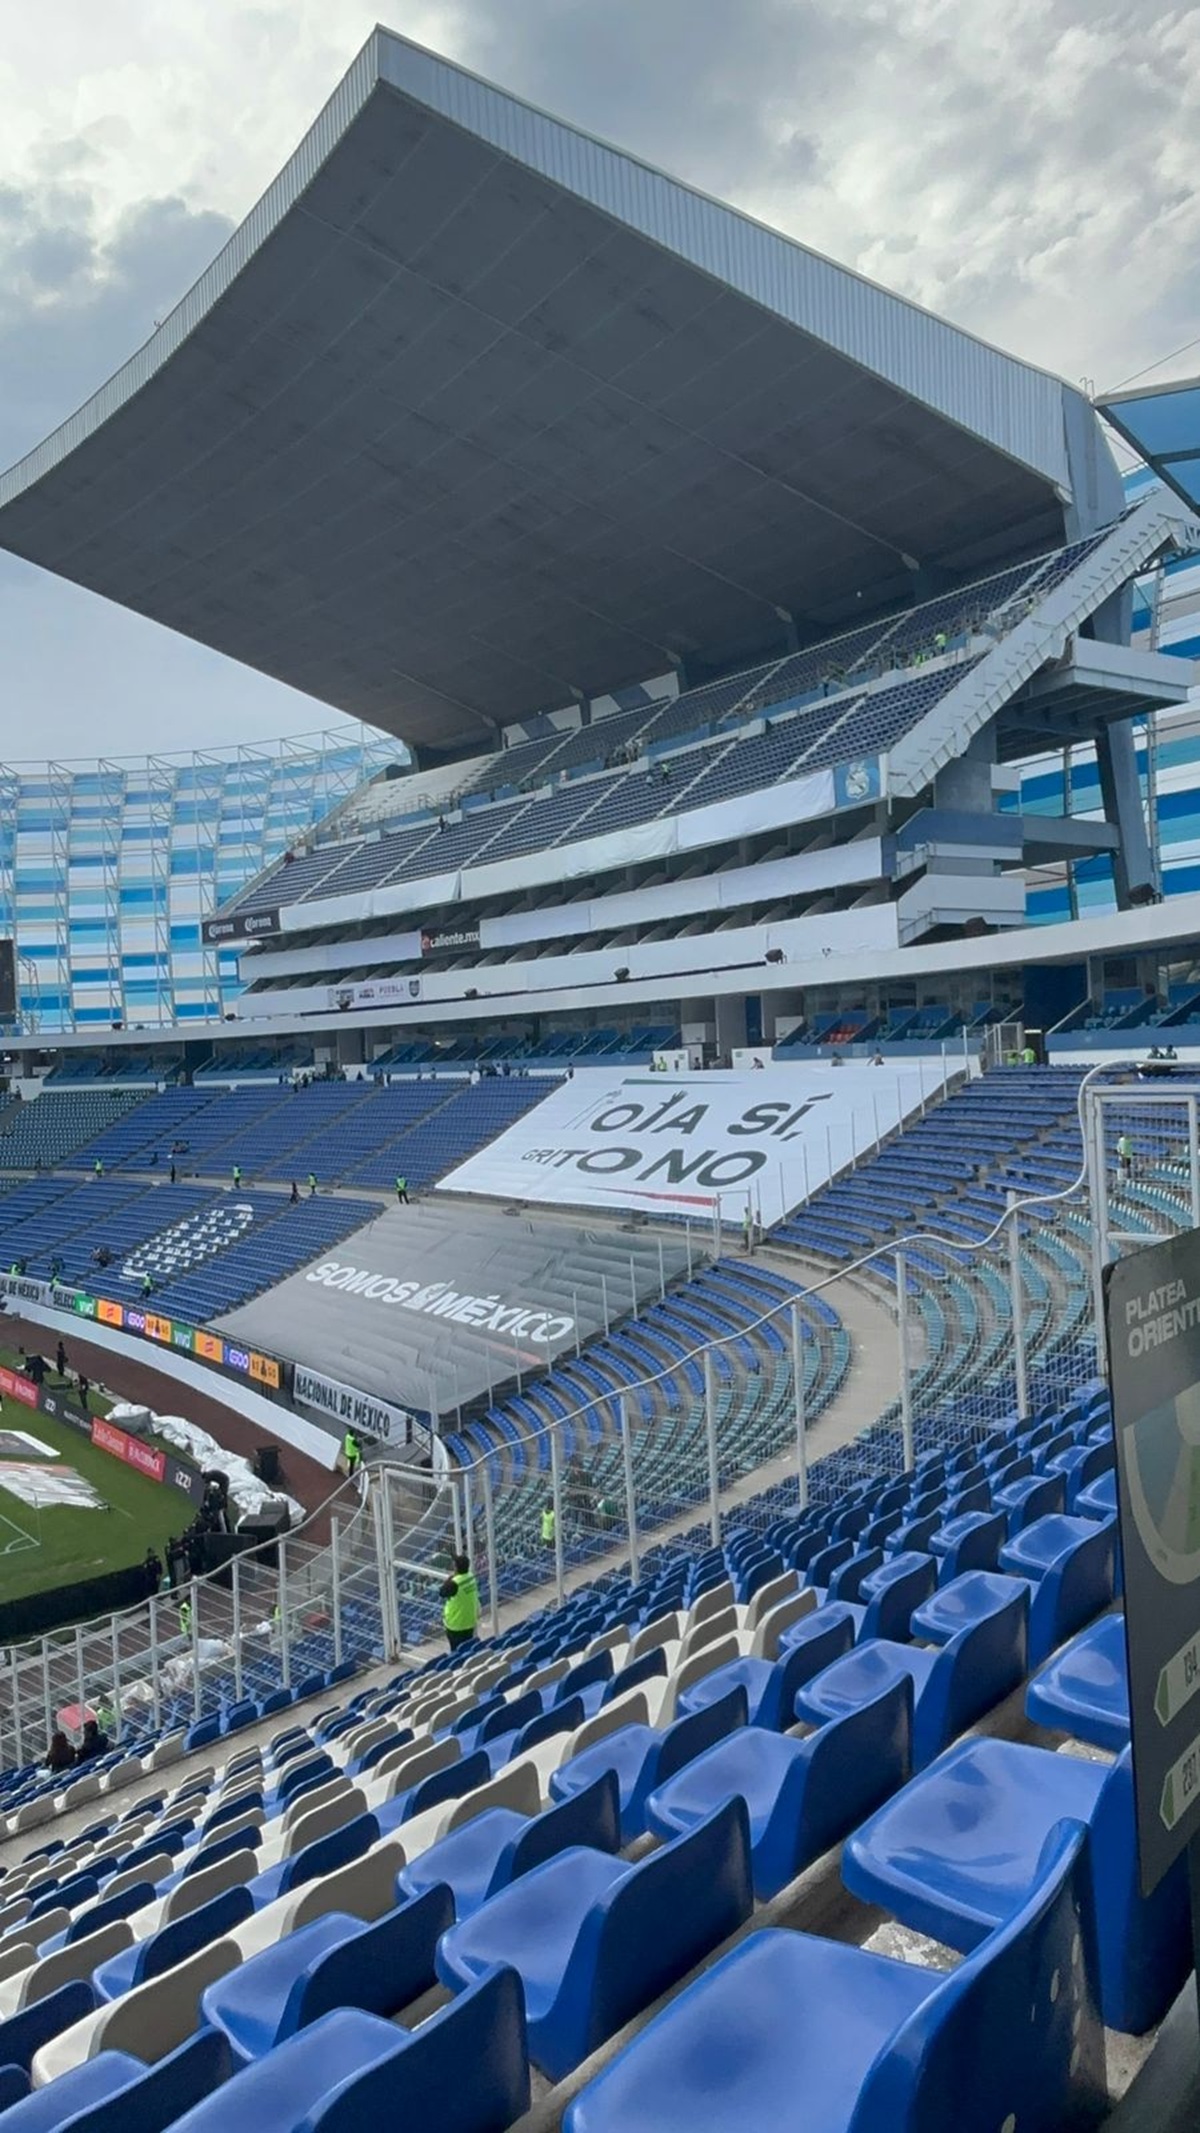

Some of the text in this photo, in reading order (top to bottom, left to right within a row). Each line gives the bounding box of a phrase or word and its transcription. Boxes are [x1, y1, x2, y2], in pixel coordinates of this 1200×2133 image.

[244, 916, 272, 932] Corona
[521, 1147, 768, 1187] GRITO NO
[305, 1262, 575, 1342] SOMOS MÉXICO
[1125, 1279, 1187, 1325] PLATEA
[1128, 1297, 1200, 1357] ORIENT
[340, 1393, 353, 1419] DE
[353, 1397, 390, 1438] MÉXICO
